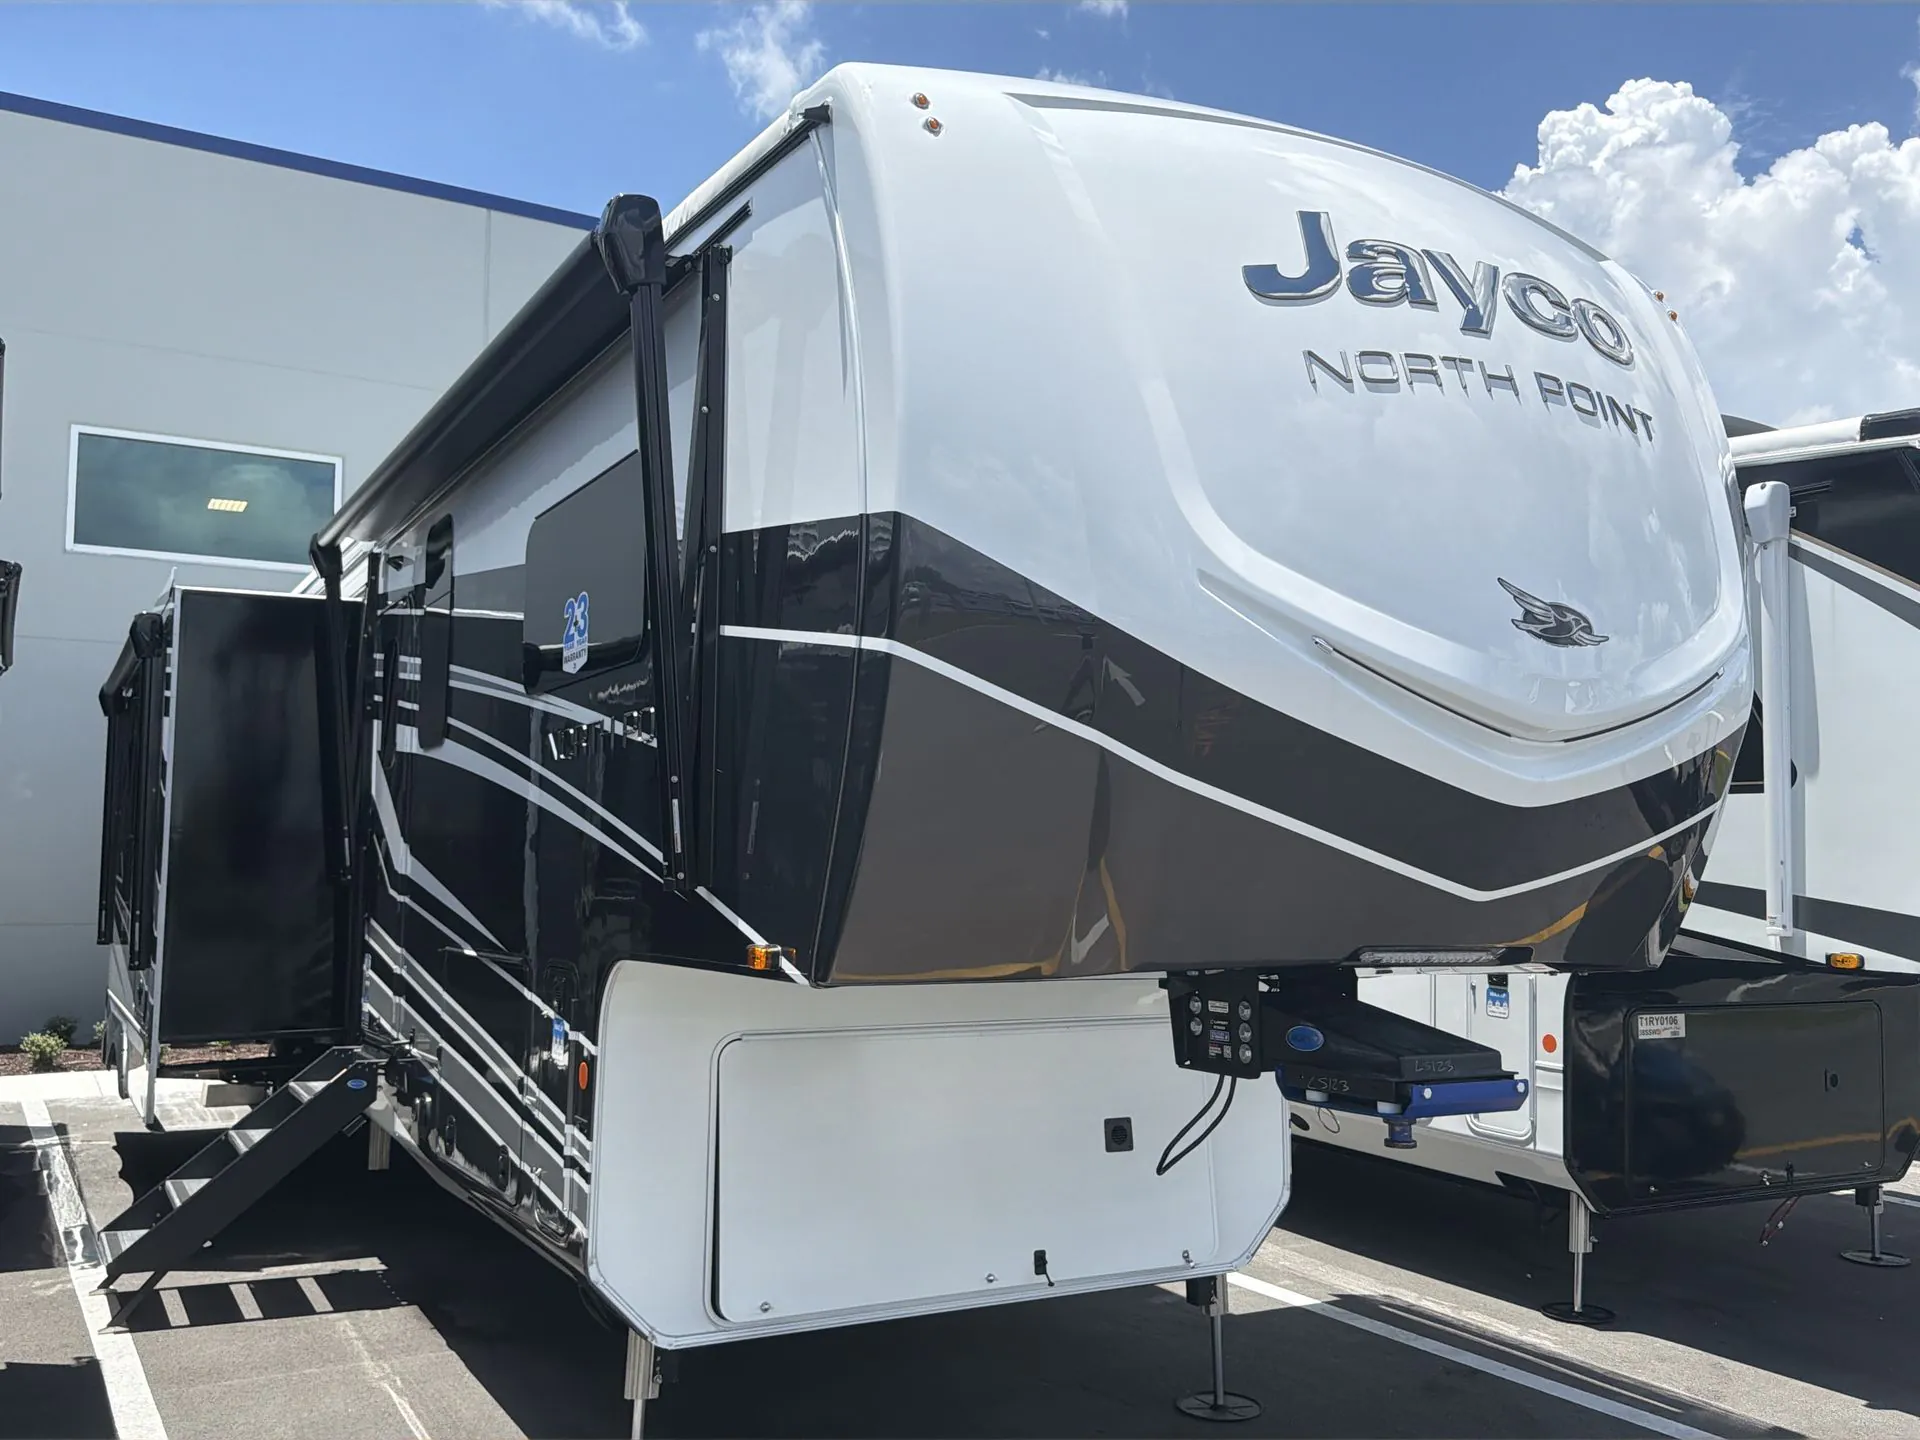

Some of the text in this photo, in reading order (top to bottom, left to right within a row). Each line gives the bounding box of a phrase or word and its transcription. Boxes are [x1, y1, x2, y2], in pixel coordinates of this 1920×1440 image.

[1242, 210, 1635, 367] Jayco
[1303, 350, 1654, 442] NORTH POINT
[564, 648, 588, 664] WARRANTY
[1639, 1015, 1679, 1027] T1RY0106
